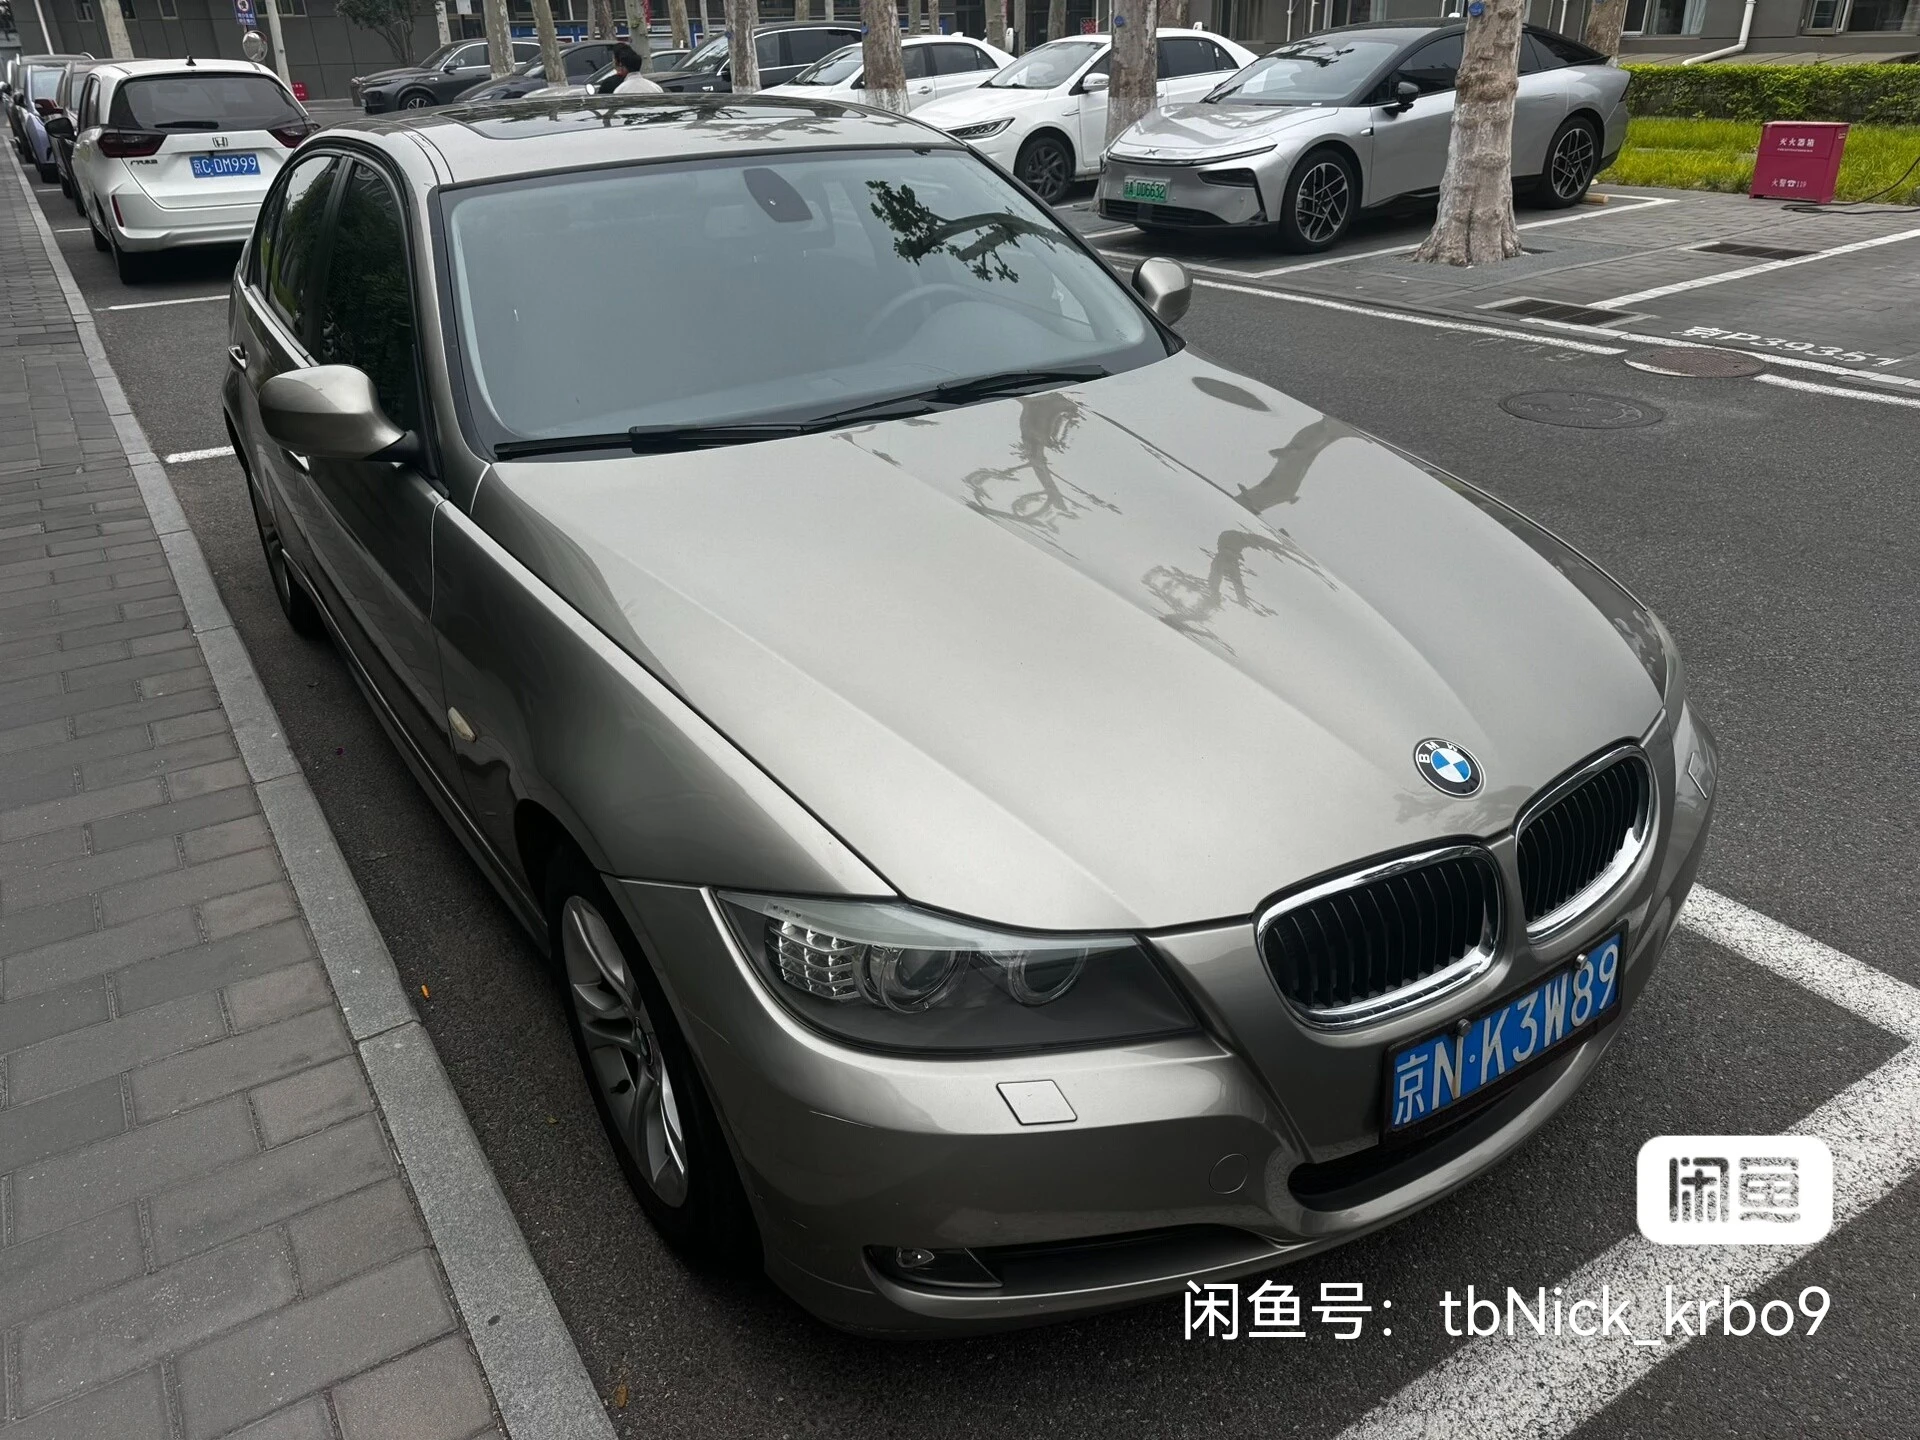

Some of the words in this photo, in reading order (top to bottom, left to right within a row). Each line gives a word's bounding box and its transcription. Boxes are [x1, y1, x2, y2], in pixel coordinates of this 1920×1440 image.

[1779, 137, 1815, 147] 灭火器箱
[1670, 325, 1903, 367] 京P39351
[1394, 944, 1619, 1125] 京N·K3W89
